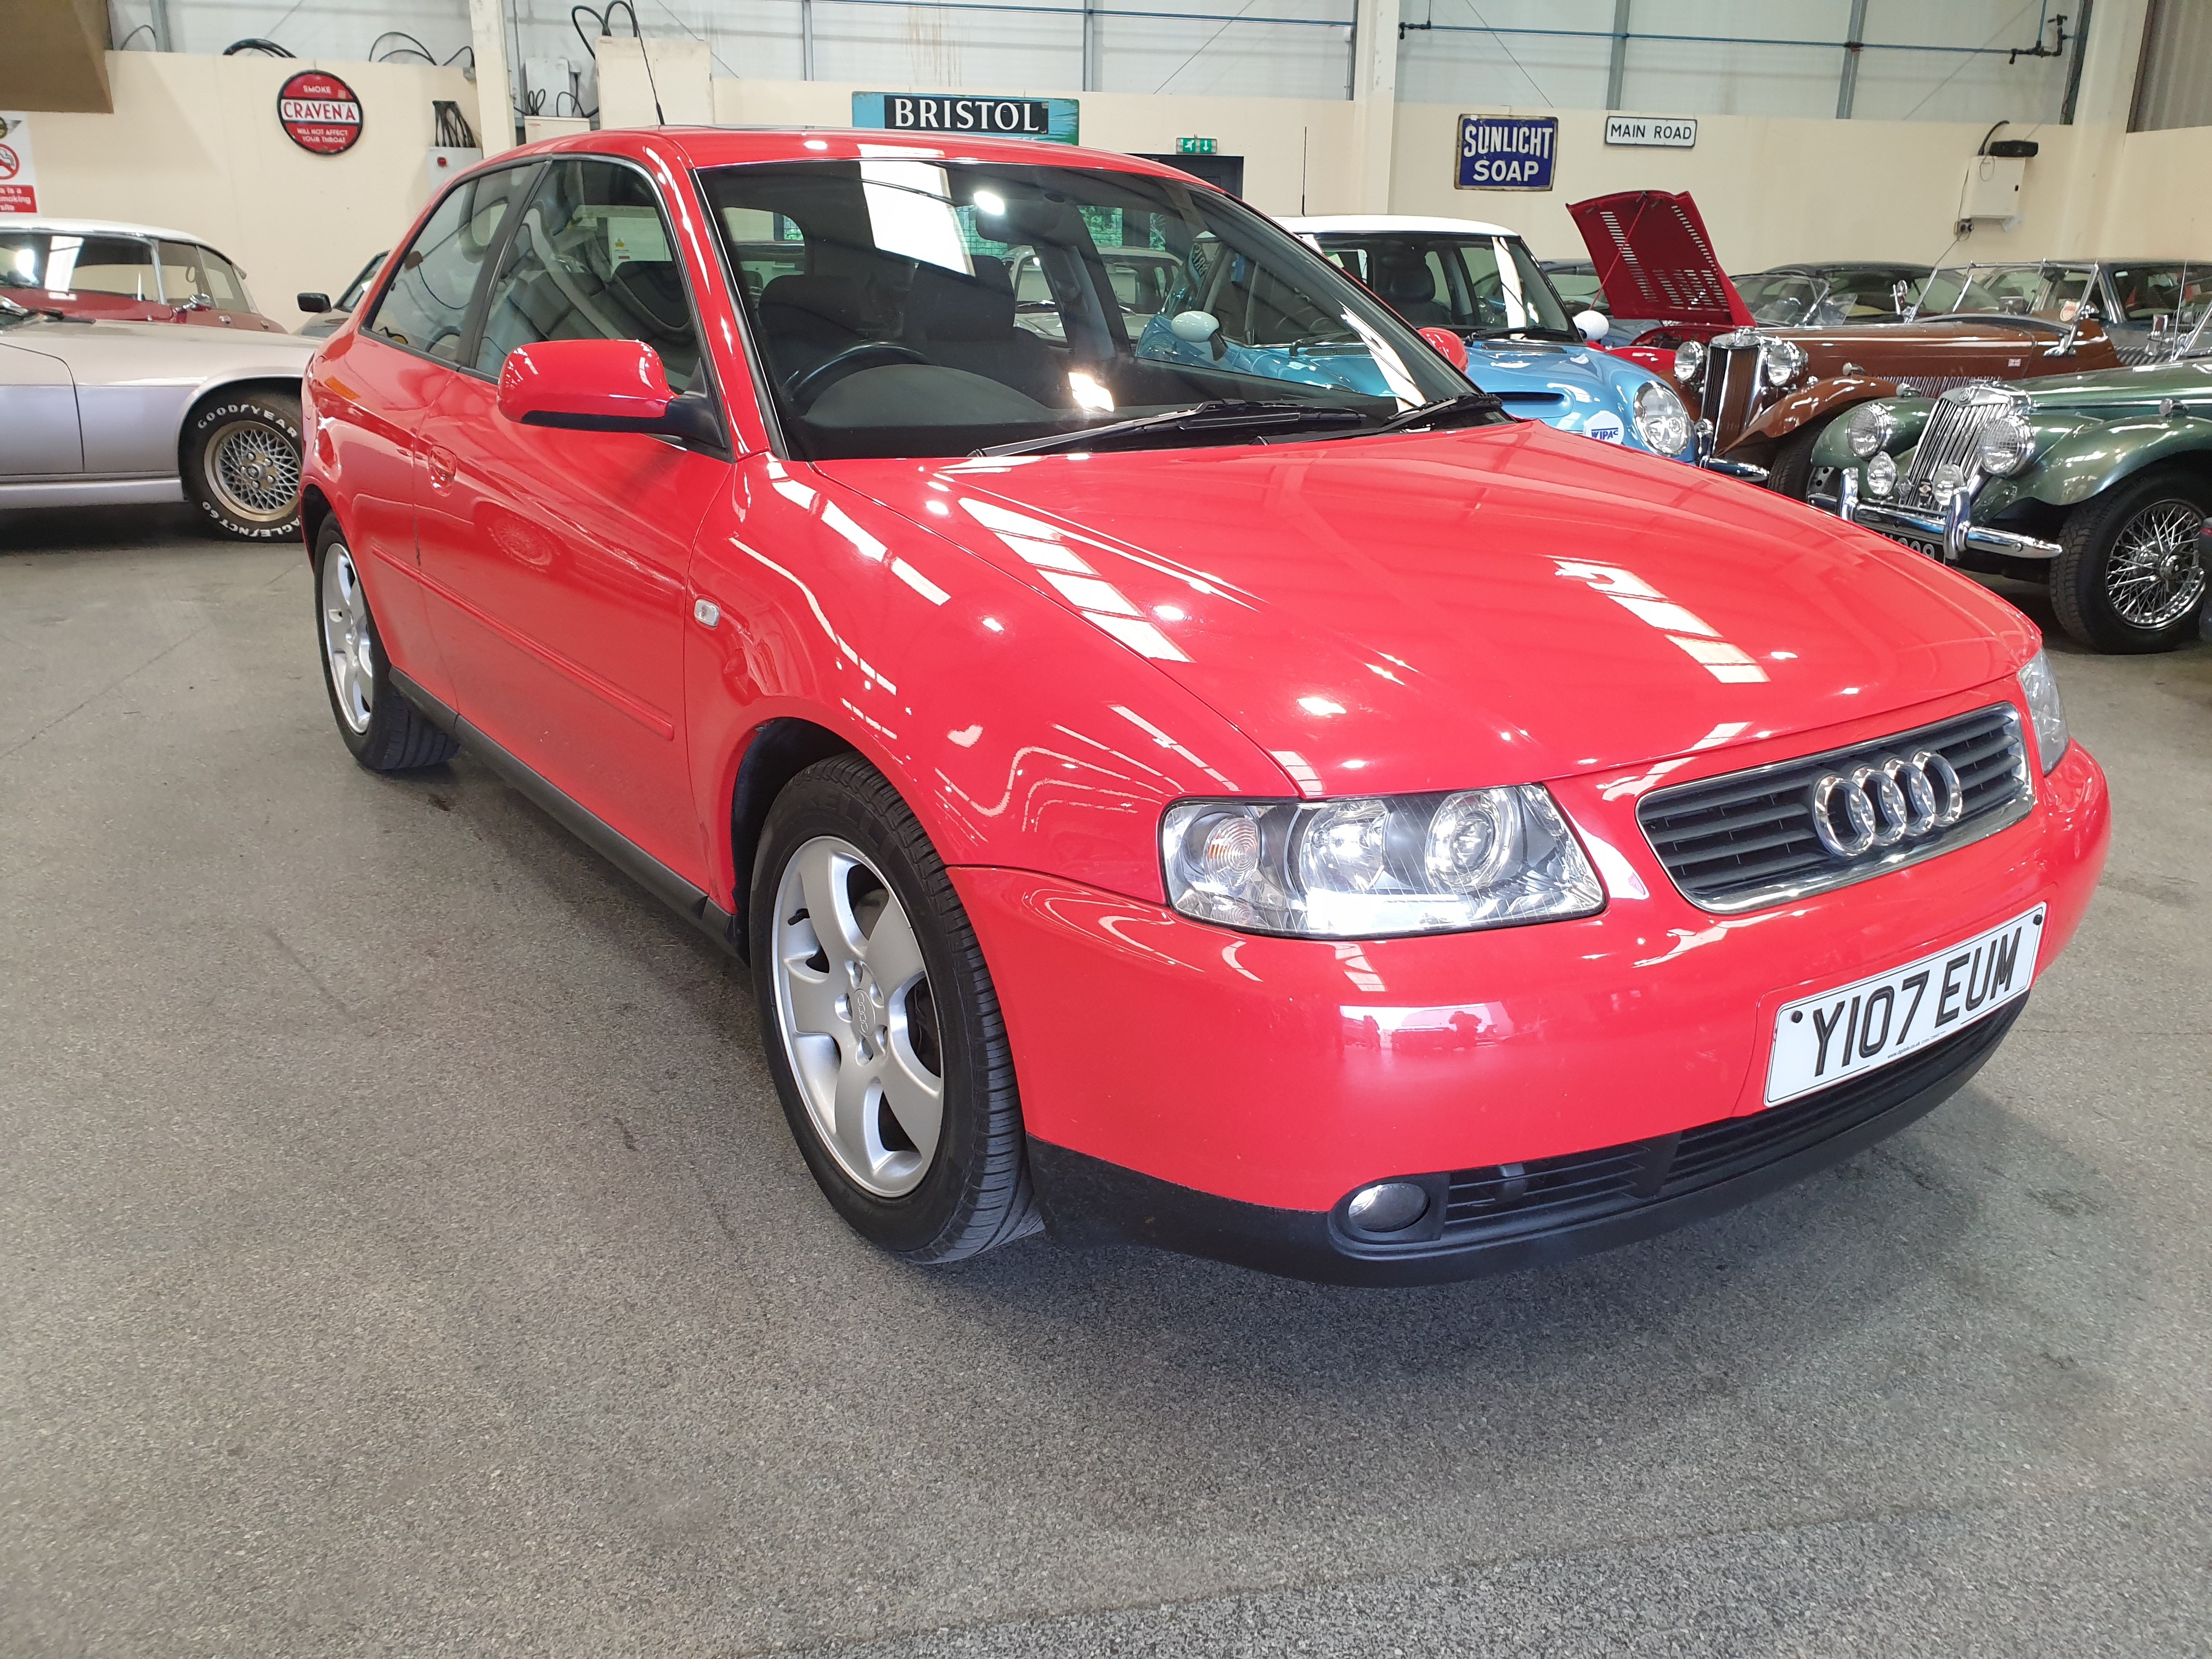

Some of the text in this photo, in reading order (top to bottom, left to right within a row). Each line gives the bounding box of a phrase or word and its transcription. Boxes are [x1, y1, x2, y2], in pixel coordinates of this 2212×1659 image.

[303, 85, 331, 93] SMOKE
[894, 98, 1040, 131] BRISTOL
[1611, 123, 1692, 139] MAIN ROAD
[1472, 160, 1539, 182] SOAP
[198, 404, 298, 438] GOODYEAR
[1592, 430, 1618, 439] WIPAC
[1812, 927, 2023, 1077] Y107 EUM
